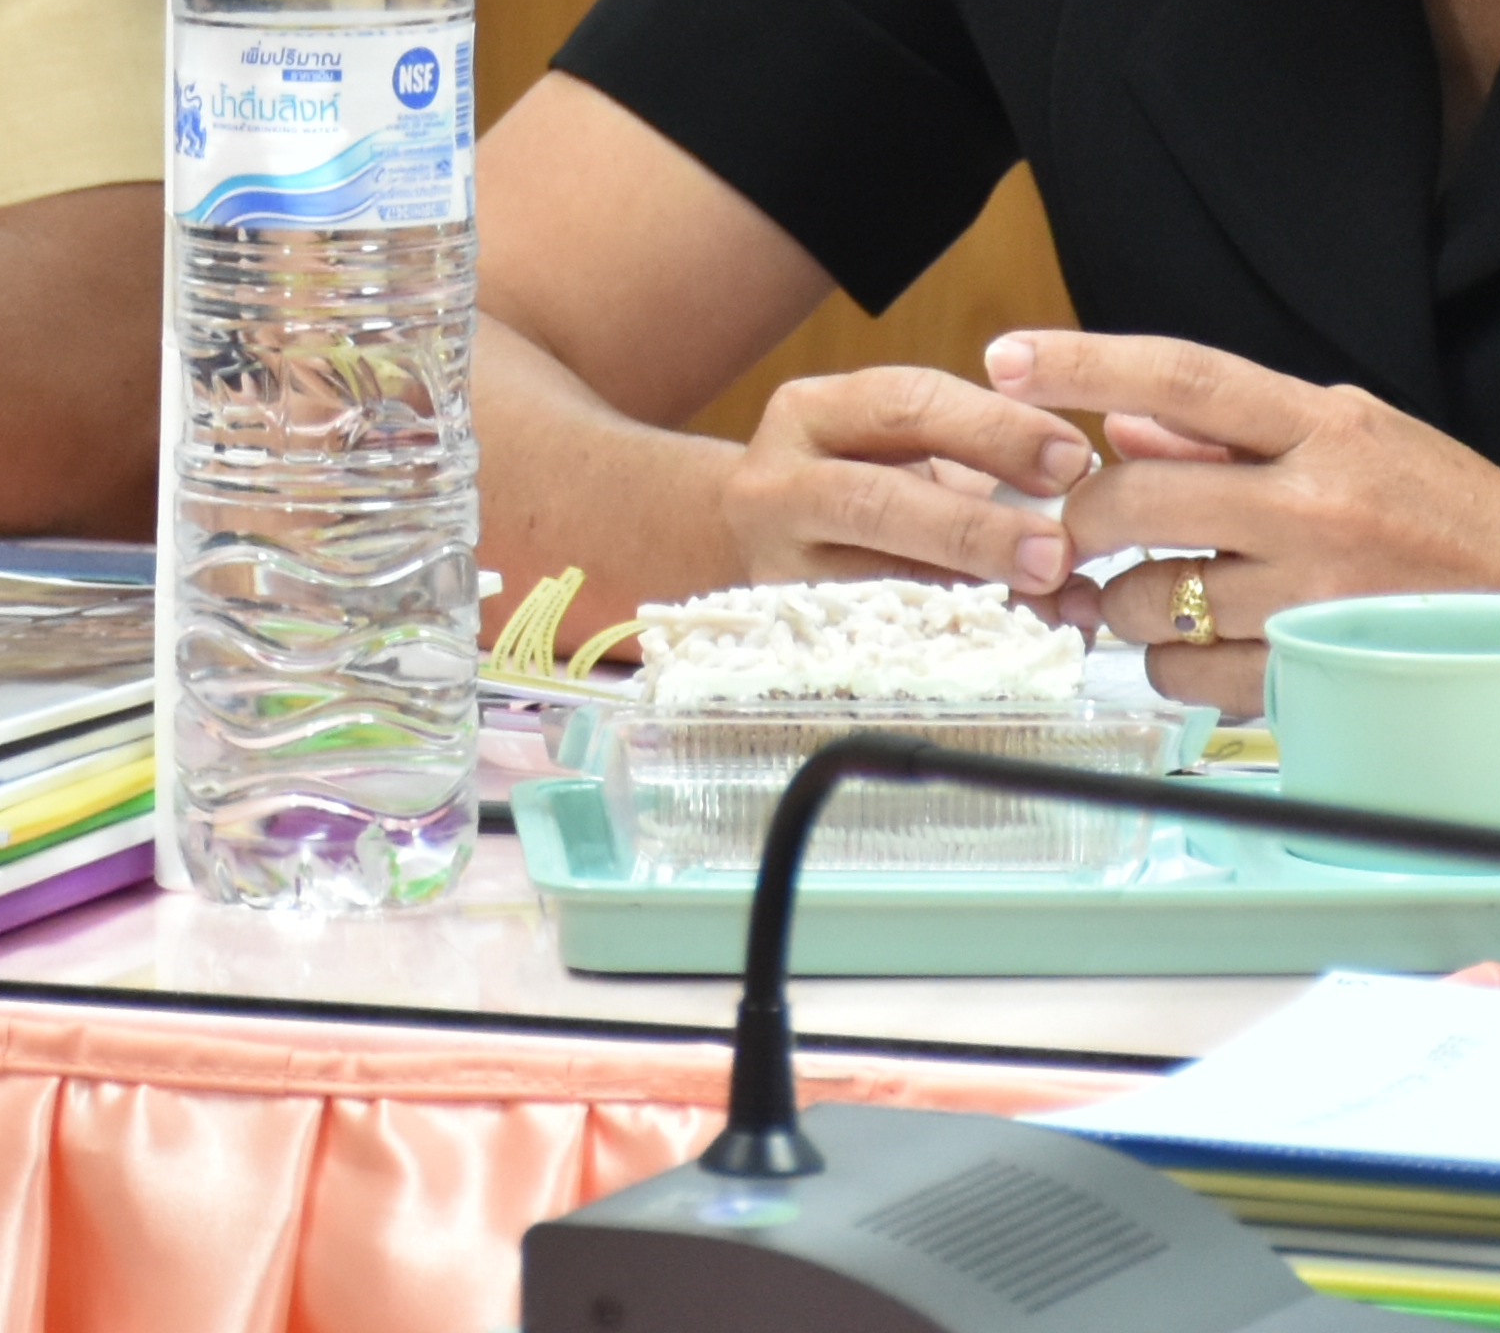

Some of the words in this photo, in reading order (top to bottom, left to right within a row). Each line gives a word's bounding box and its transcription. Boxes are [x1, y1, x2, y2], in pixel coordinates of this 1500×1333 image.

[398, 62, 435, 95] NSF
[211, 82, 342, 123] น้ำดื่มสิงห์
